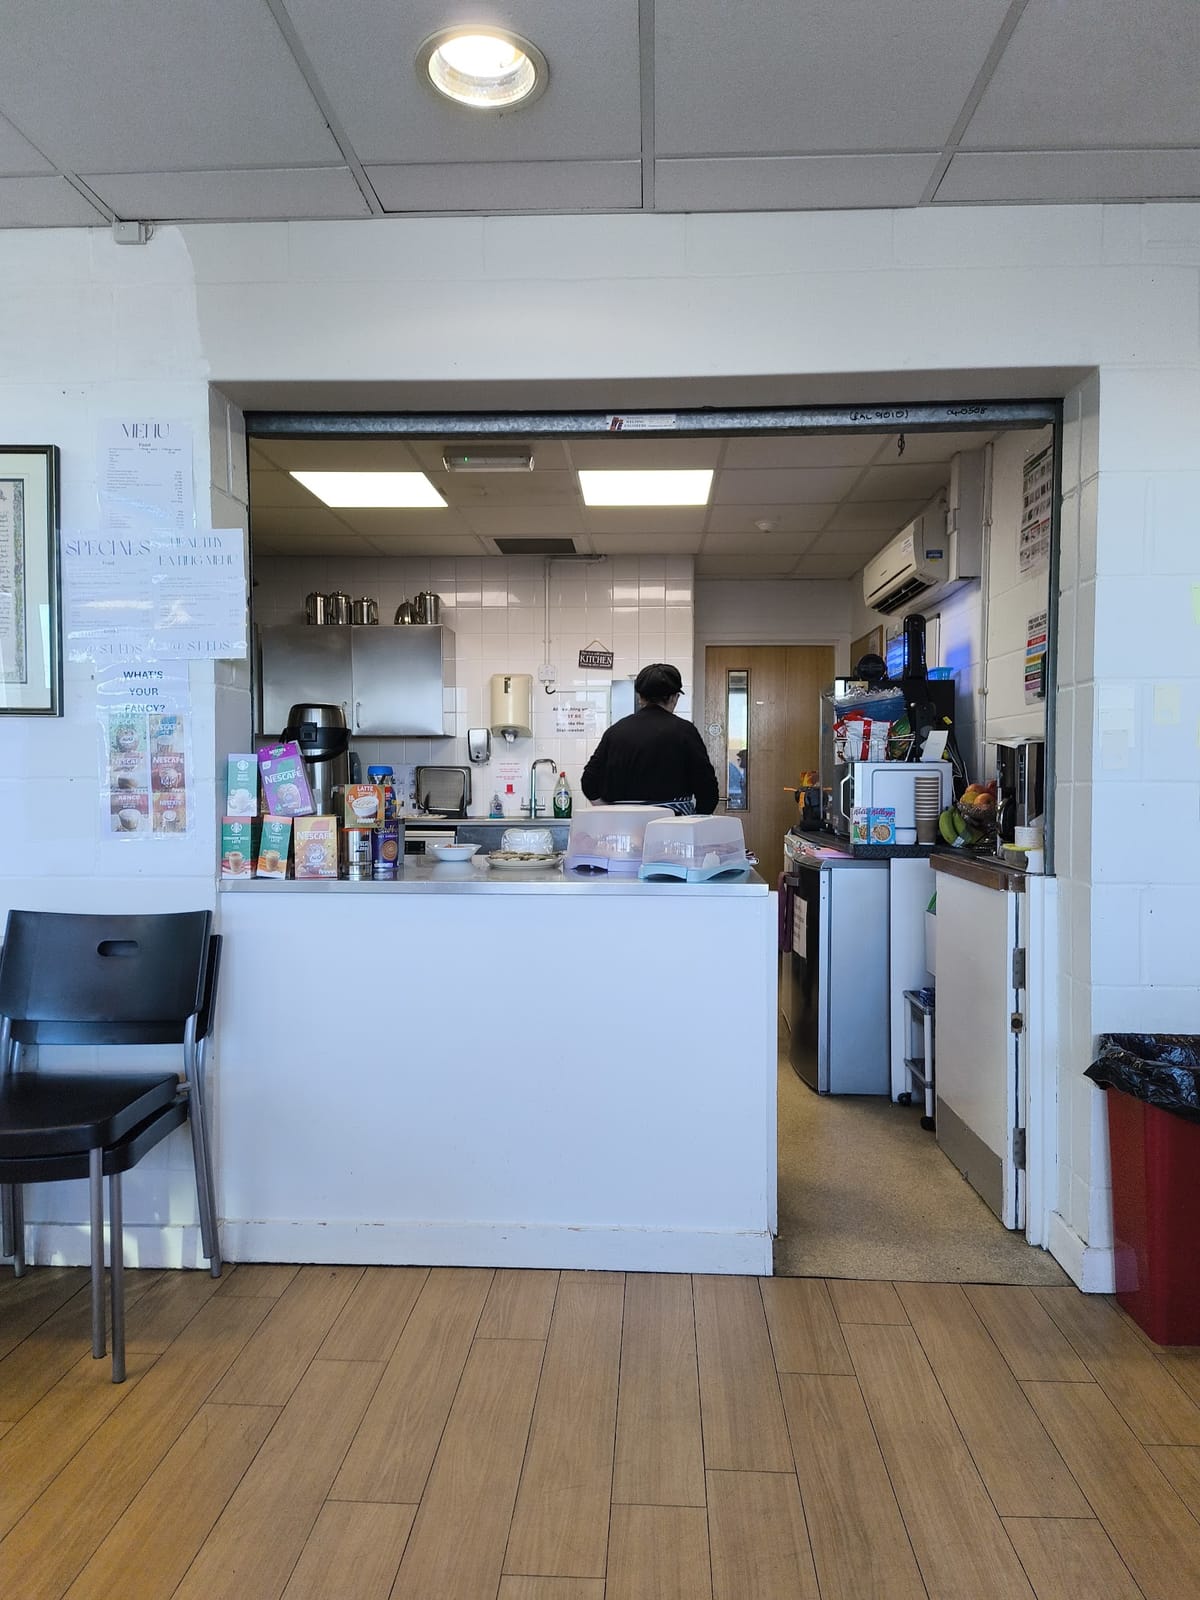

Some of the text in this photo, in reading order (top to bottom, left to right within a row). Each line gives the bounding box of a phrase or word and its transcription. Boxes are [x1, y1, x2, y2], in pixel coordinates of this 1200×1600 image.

[121, 423, 170, 439] MENU
[65, 539, 151, 556] SPECIALS
[580, 655, 613, 665] KITCHEN
[123, 670, 164, 680] WHAT'S
[128, 687, 159, 697] YOUR
[124, 704, 166, 713] FANCY?
[264, 766, 304, 785] NESCAFÉ
